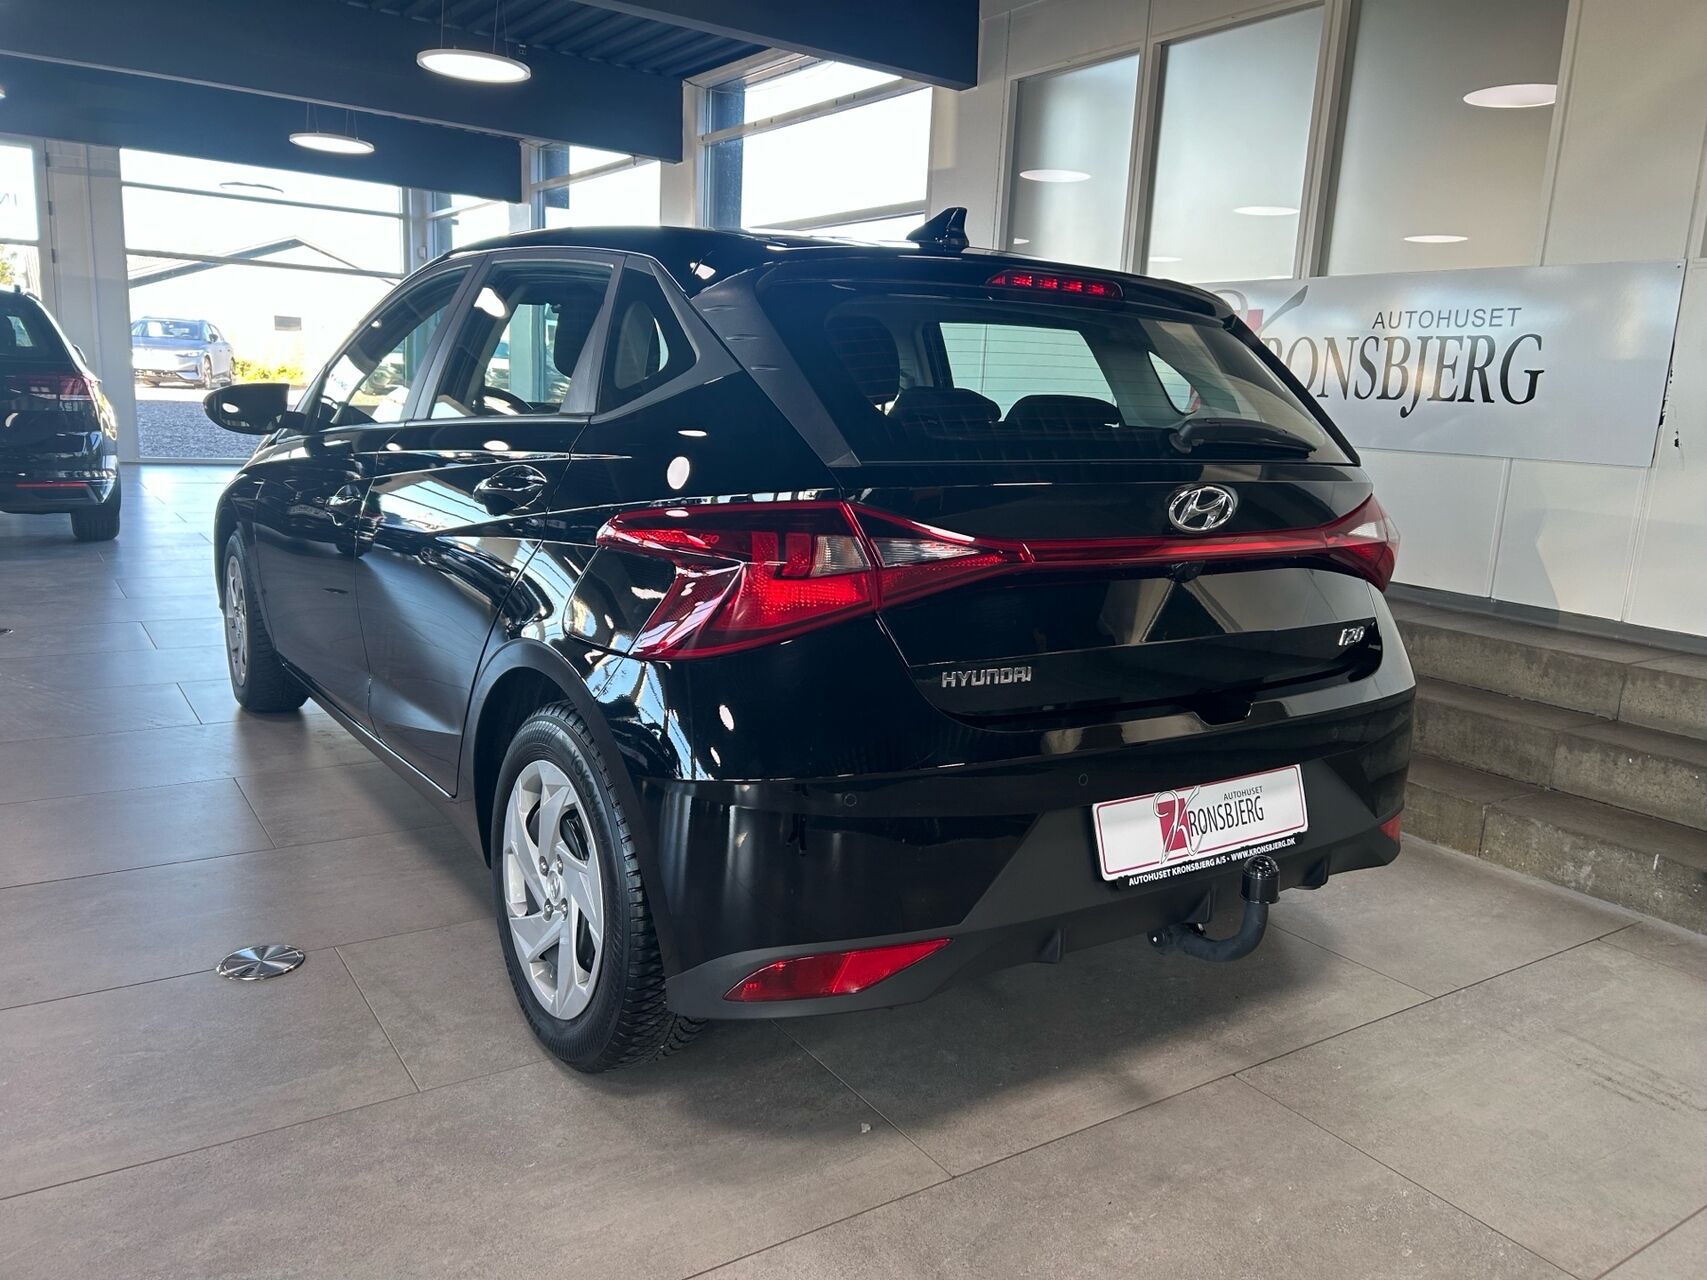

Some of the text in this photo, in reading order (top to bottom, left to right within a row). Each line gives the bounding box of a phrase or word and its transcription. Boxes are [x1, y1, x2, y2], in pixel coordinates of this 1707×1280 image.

[1372, 307, 1522, 329] AUTOHUSET
[942, 666, 1032, 688] HYUNDAI
[1223, 786, 1263, 801] AUTOHUSET
[1128, 837, 1296, 887] AUTOHUSET KRONSBJERG A/S WWW.KRONSBJERG.DK
